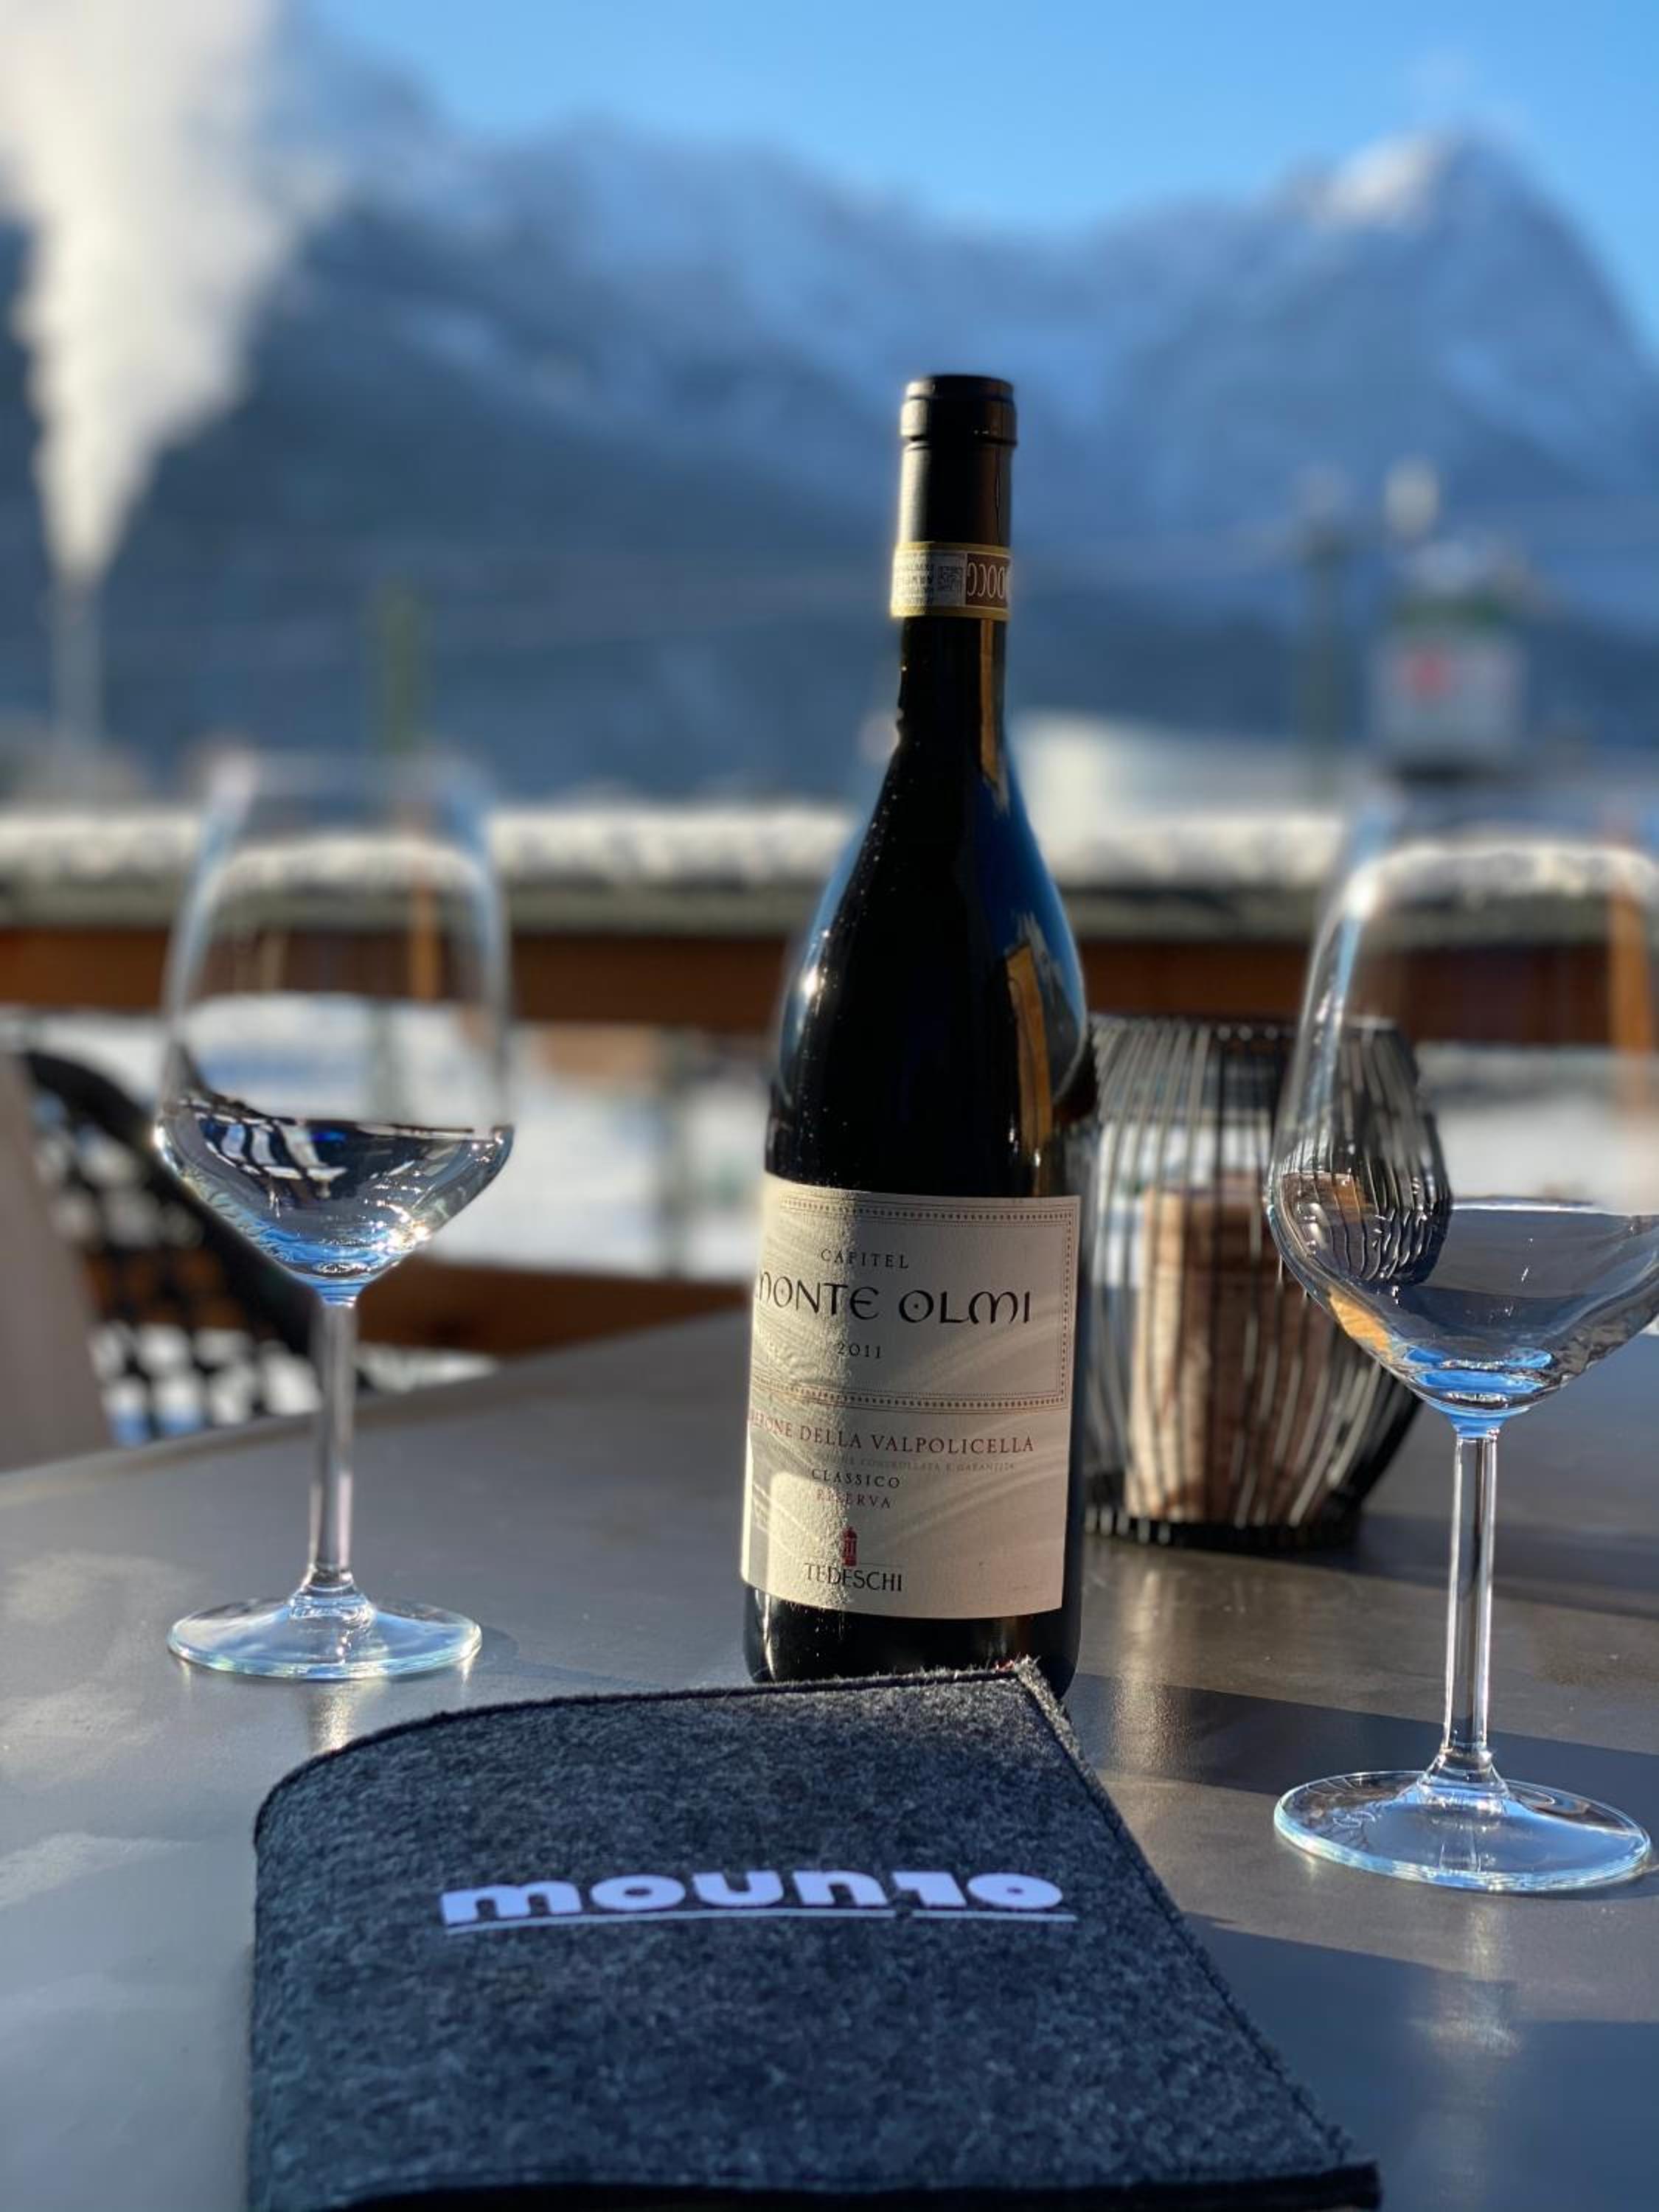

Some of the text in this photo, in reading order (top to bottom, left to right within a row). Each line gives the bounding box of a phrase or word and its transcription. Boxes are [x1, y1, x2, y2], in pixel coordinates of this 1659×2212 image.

[820, 1248, 909, 1269] CAPITEL
[899, 1290, 1031, 1324] OLMI
[837, 1342, 881, 1359] 2011
[800, 1425, 862, 1449] DELLA
[871, 1434, 1034, 1455] VALPOLICELLA
[812, 1467, 900, 1489] CLASSICO
[816, 1488, 891, 1509] RISERVA
[804, 1562, 902, 1592] TEDESCHI
